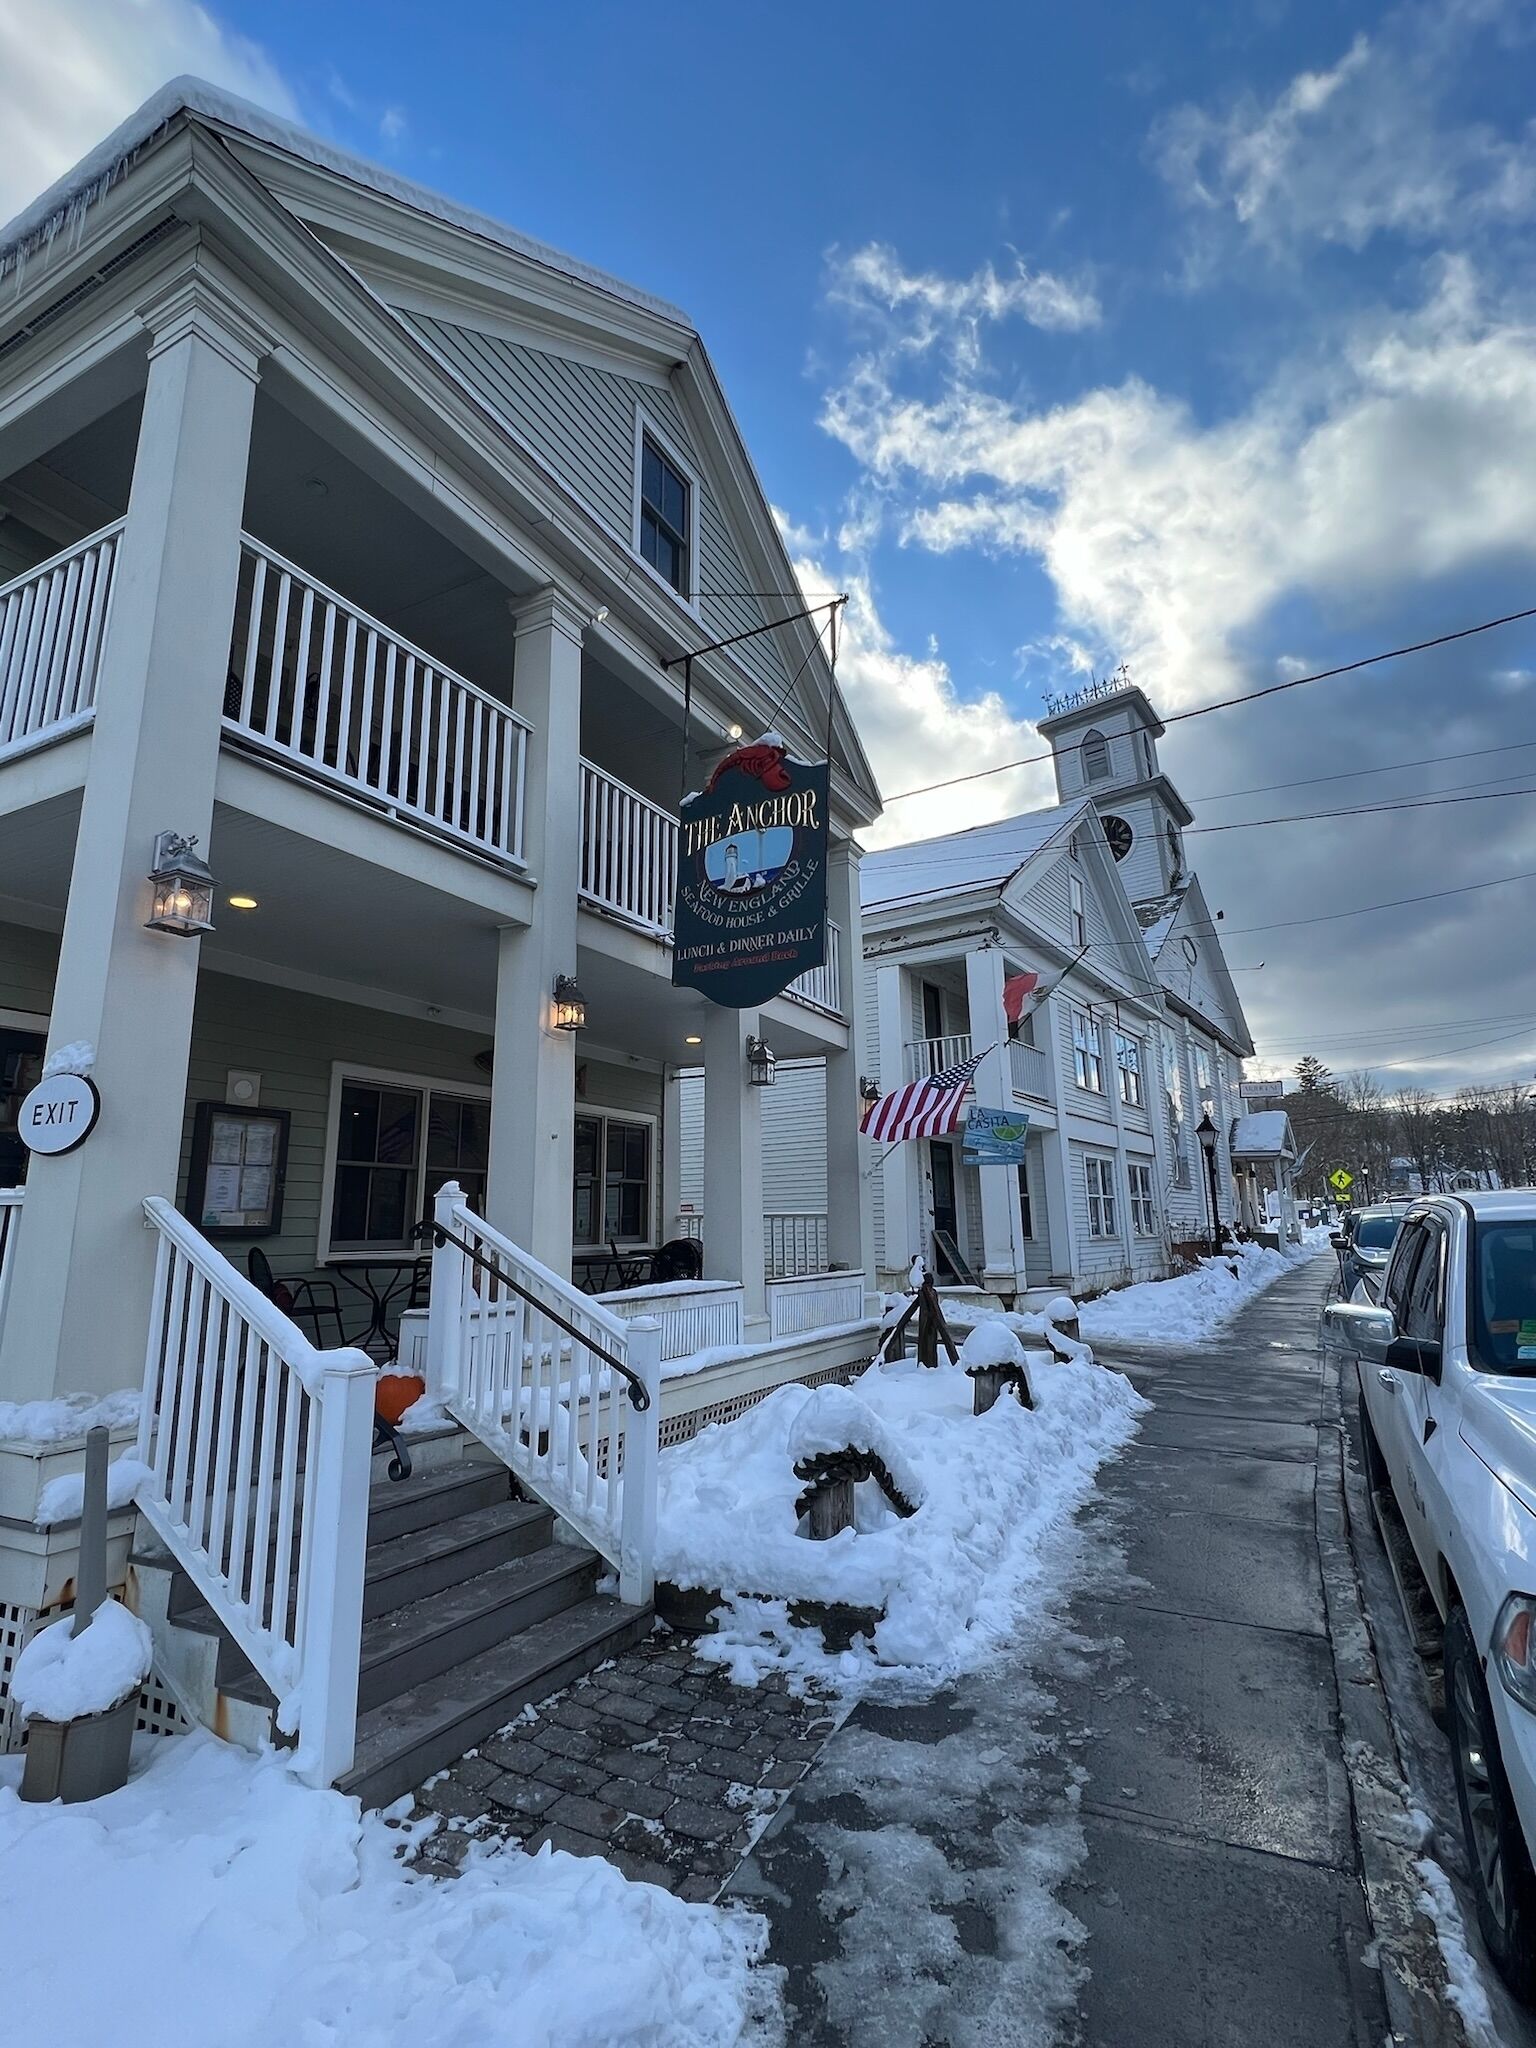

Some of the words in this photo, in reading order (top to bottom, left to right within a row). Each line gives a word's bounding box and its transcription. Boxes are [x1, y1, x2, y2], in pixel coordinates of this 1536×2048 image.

[685, 813, 723, 857] THE
[726, 789, 820, 837] ANCHOR
[680, 885, 724, 928] SEAFOOD
[725, 912, 766, 930] HOUSE
[767, 907, 779, 920] &
[778, 858, 820, 906] GRILLE
[697, 878, 729, 912] NEW
[728, 859, 801, 913] ENGLAND
[677, 944, 714, 962] LUNCH
[716, 943, 727, 955] &
[729, 933, 775, 954] DINNER
[777, 922, 819, 946] DAILY
[32, 1100, 79, 1126] EXIT
[967, 1115, 1010, 1130] CASITA
[969, 1108, 985, 1120] LA
